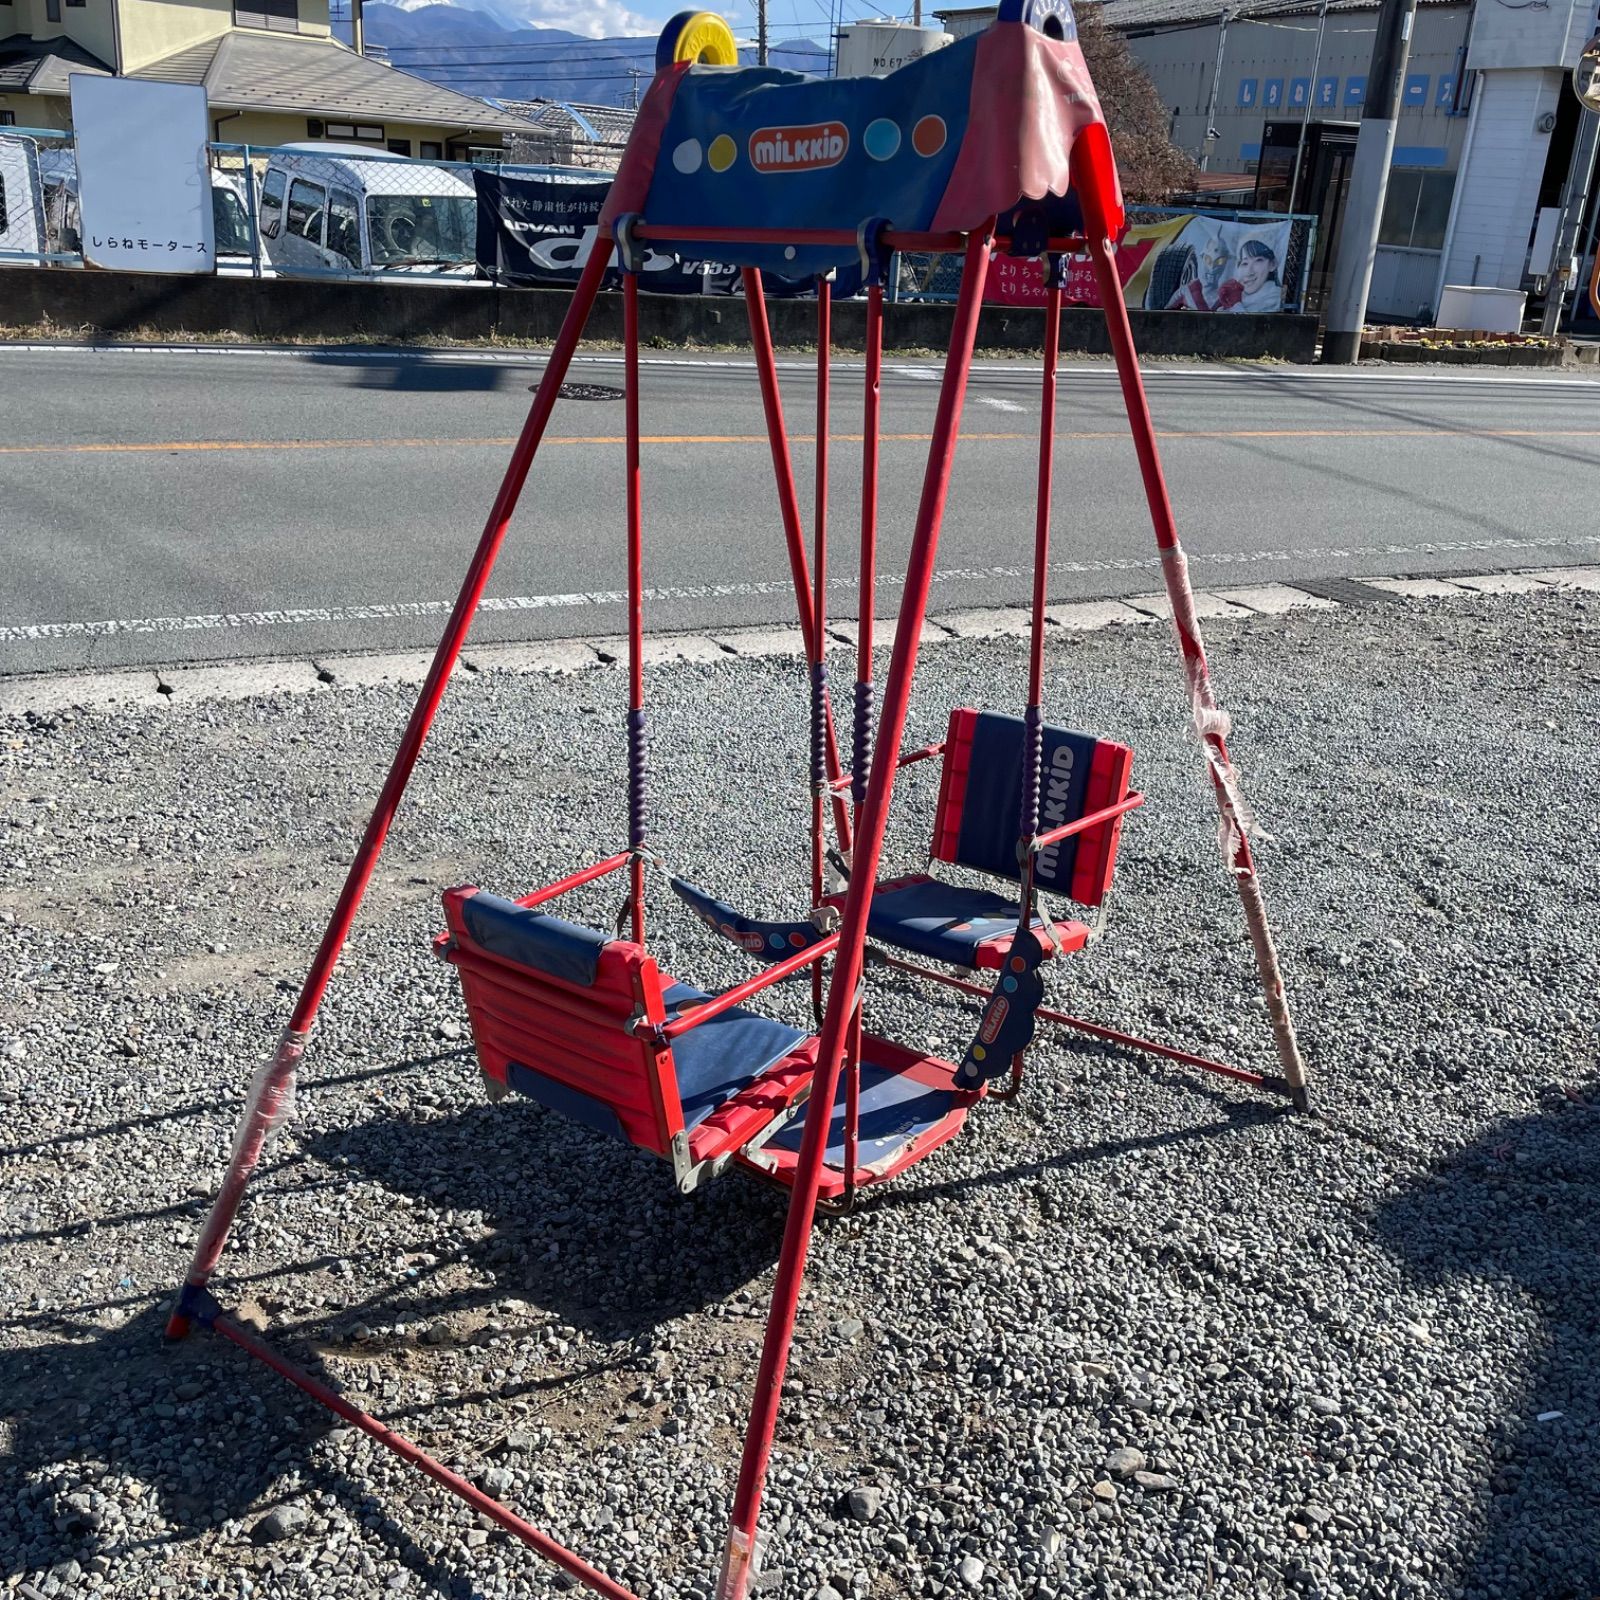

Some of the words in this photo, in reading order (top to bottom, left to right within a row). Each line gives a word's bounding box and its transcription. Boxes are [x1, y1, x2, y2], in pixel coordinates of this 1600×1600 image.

[1243, 83, 1452, 104] しらねモーース
[92, 236, 208, 253] しらねモータース
